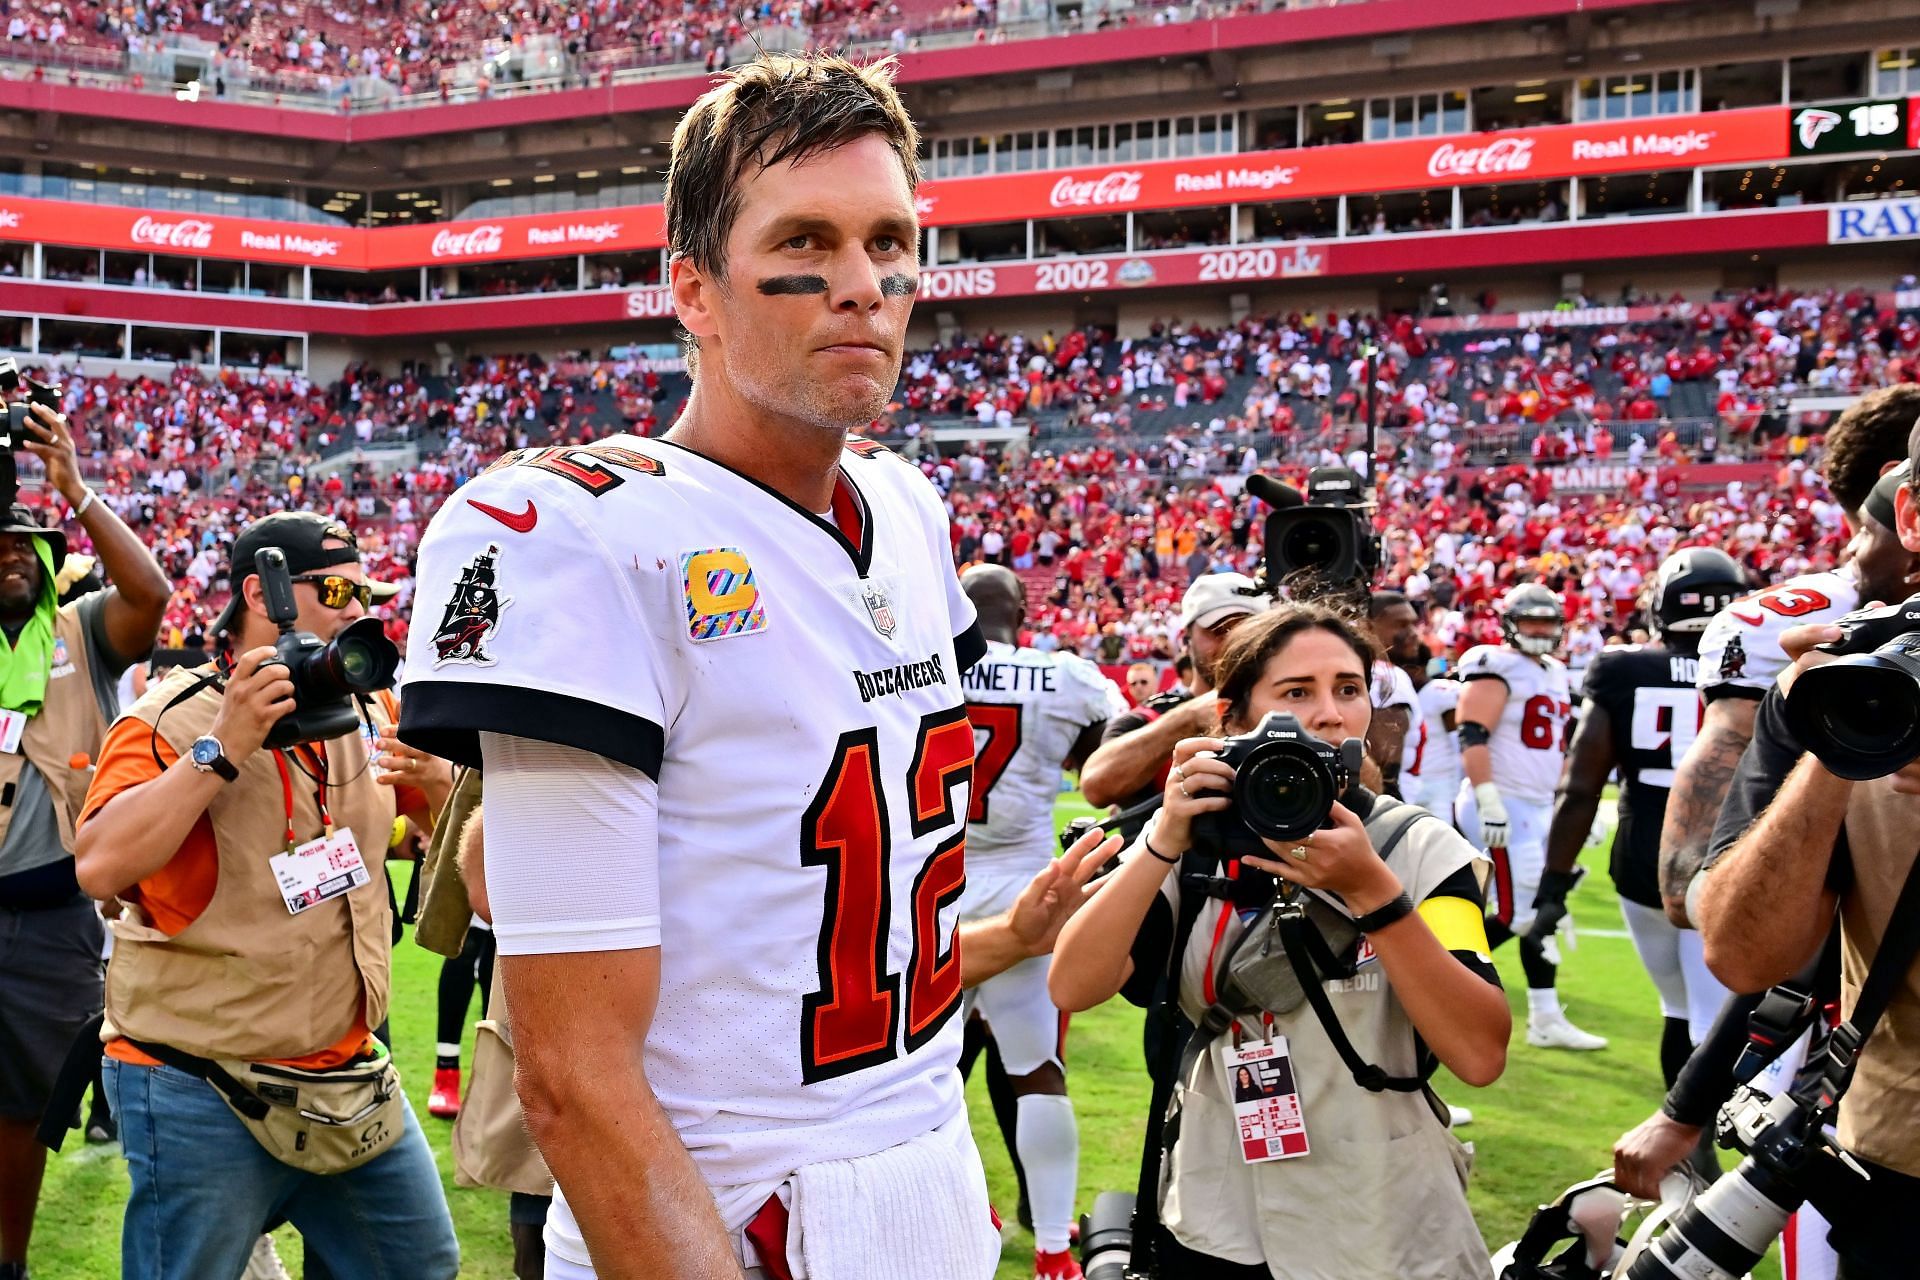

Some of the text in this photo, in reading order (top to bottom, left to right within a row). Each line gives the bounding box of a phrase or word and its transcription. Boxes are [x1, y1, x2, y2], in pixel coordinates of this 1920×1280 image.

[1849, 104, 1899, 136] 15
[1428, 137, 1536, 177] Coca-Cola
[1572, 130, 1709, 160] Real Magic
[1050, 171, 1144, 208] Coca-Cola
[1174, 165, 1294, 192] Real Magic
[131, 215, 214, 248] Coca-Cola
[241, 231, 338, 257] Real Magic
[432, 225, 504, 257] Coca-Cola
[528, 222, 619, 245] Real Magic
[921, 268, 996, 298] IONS
[1036, 261, 1109, 292] 2002
[1200, 250, 1277, 281] 2020
[687, 552, 756, 616] C
[852, 653, 946, 702] BUCCANEERS
[1267, 731, 1297, 739] Canon
[800, 704, 974, 1086] 12
